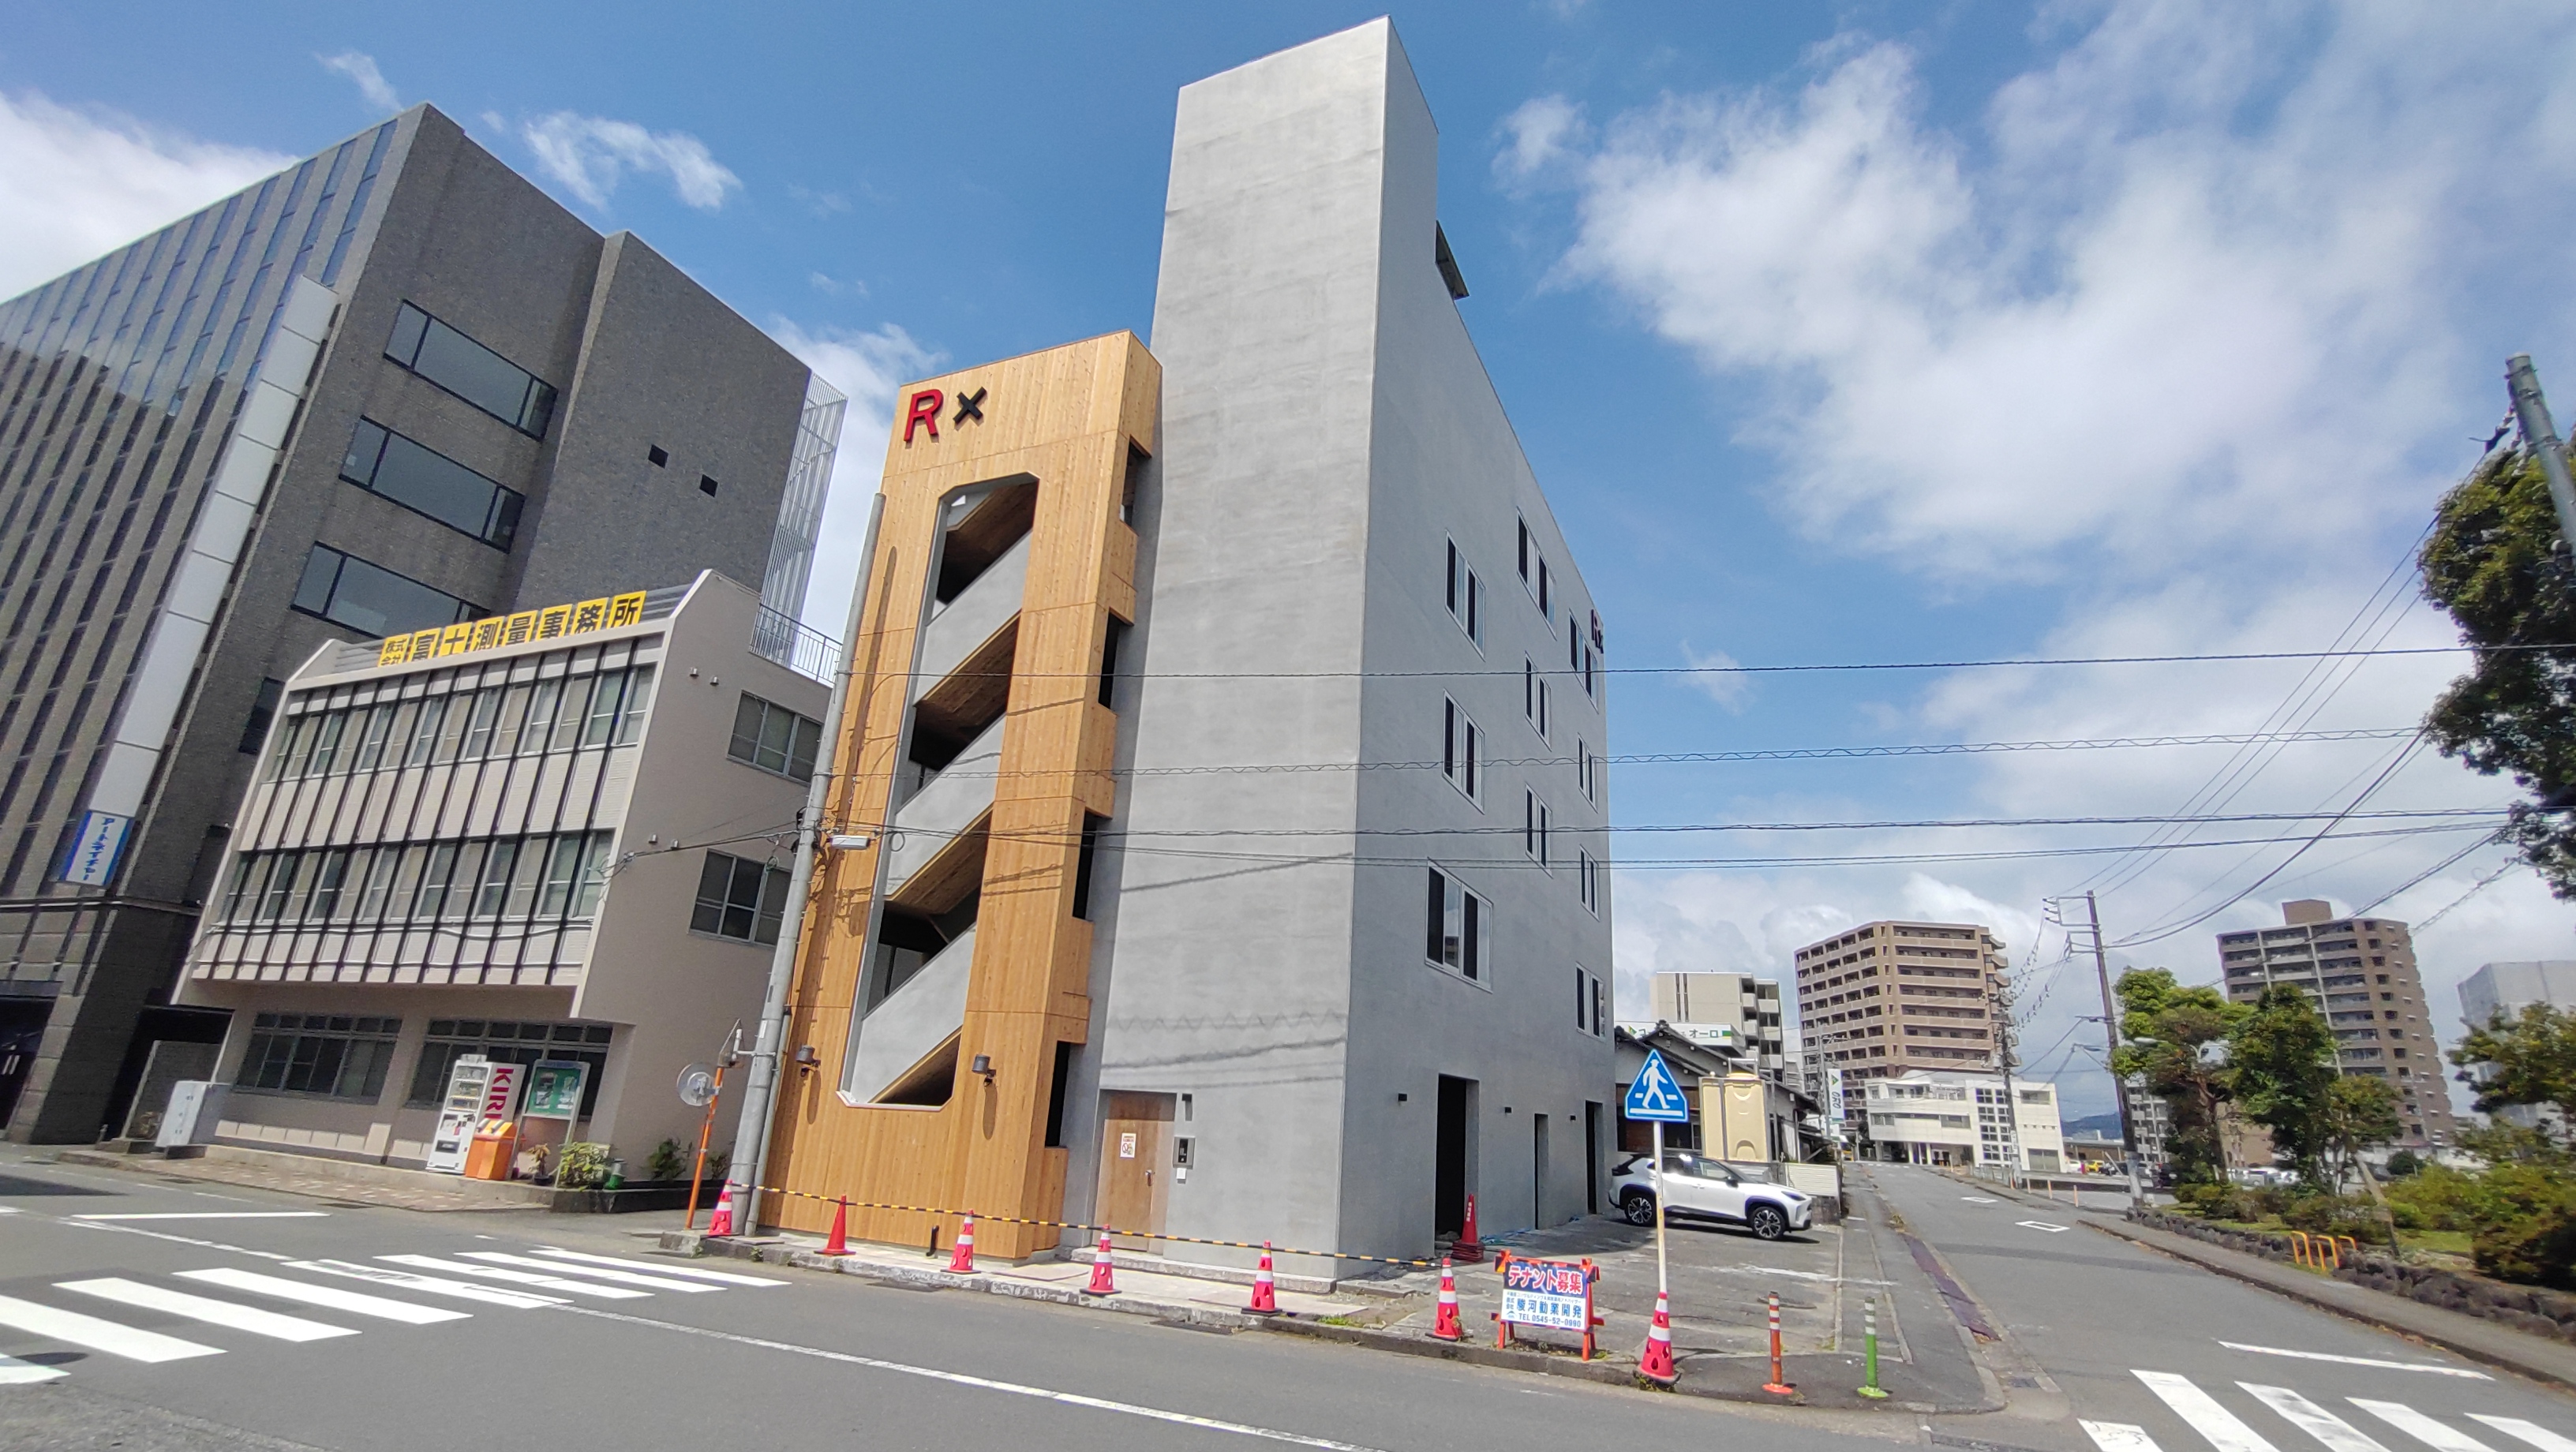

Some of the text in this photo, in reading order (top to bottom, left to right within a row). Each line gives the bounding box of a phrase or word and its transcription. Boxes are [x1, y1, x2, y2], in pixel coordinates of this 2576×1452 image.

[485, 1068, 514, 1118] KIRI
[1508, 1266, 1583, 1295] テナント募集
